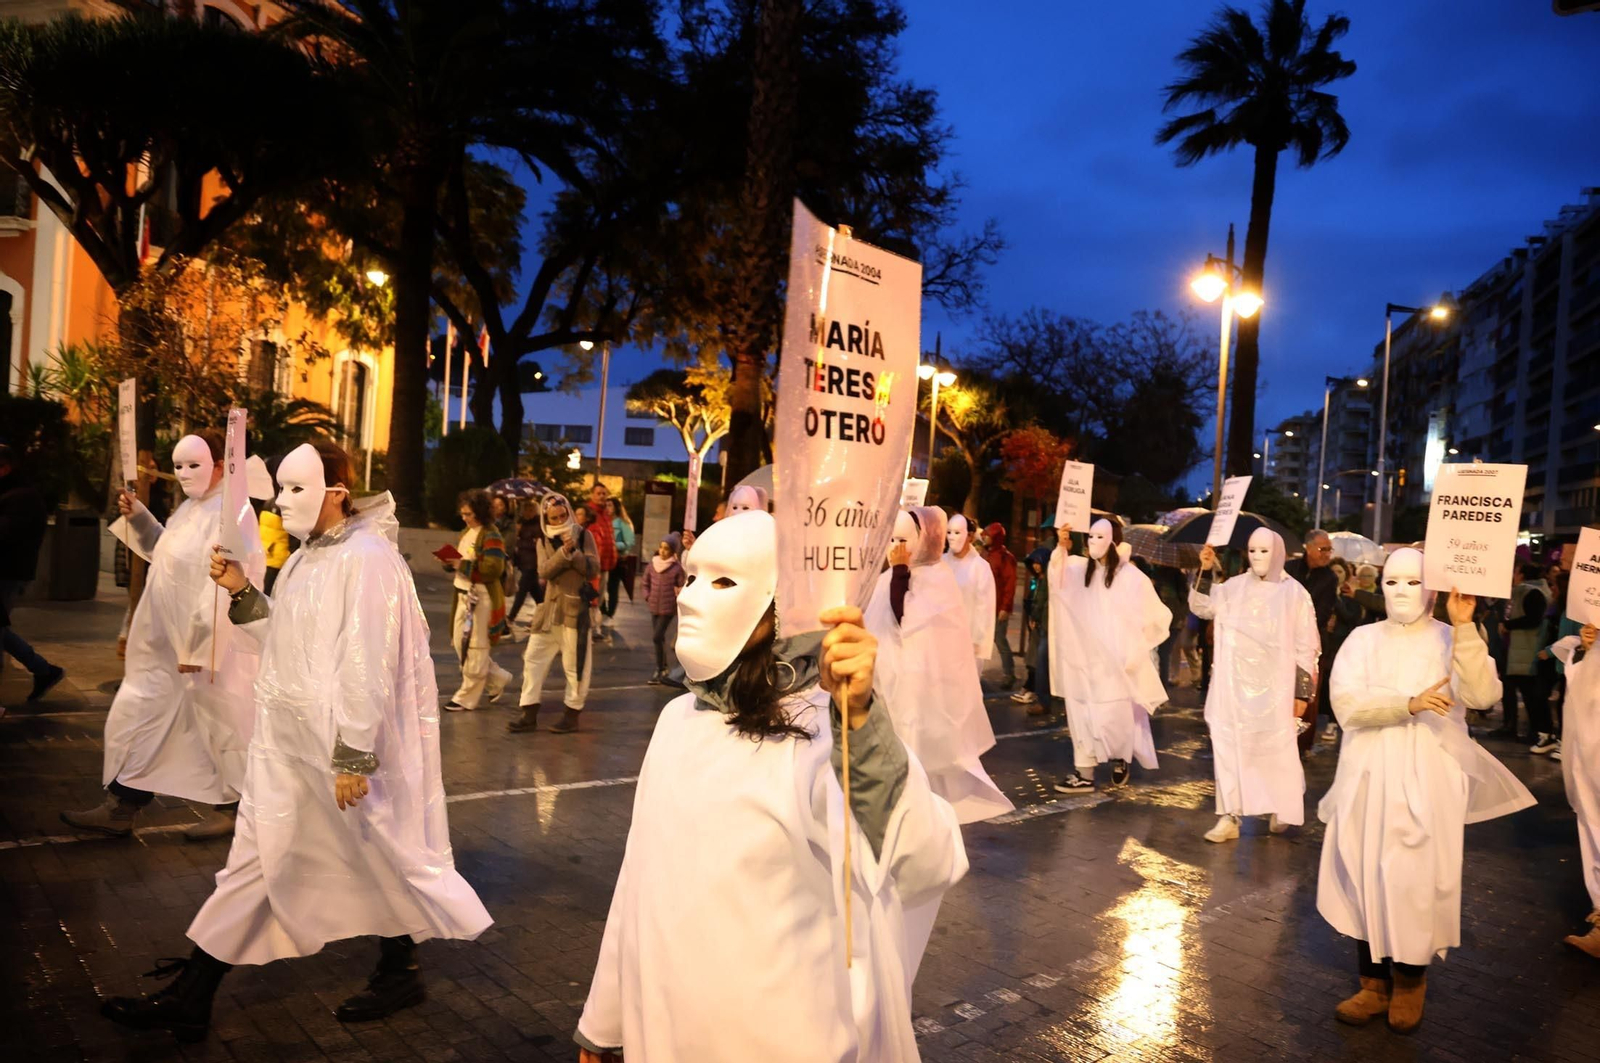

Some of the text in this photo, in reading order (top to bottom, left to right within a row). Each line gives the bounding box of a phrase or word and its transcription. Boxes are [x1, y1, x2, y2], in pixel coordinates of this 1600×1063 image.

[809, 313, 885, 360] MARÍA
[804, 406, 886, 446] OTERO
[1437, 495, 1513, 508] FRANCISCA
[803, 496, 880, 529] 36 años
[1442, 510, 1503, 523] PAREDES
[1462, 540, 1489, 552] años
[1453, 554, 1478, 564] BEAS
